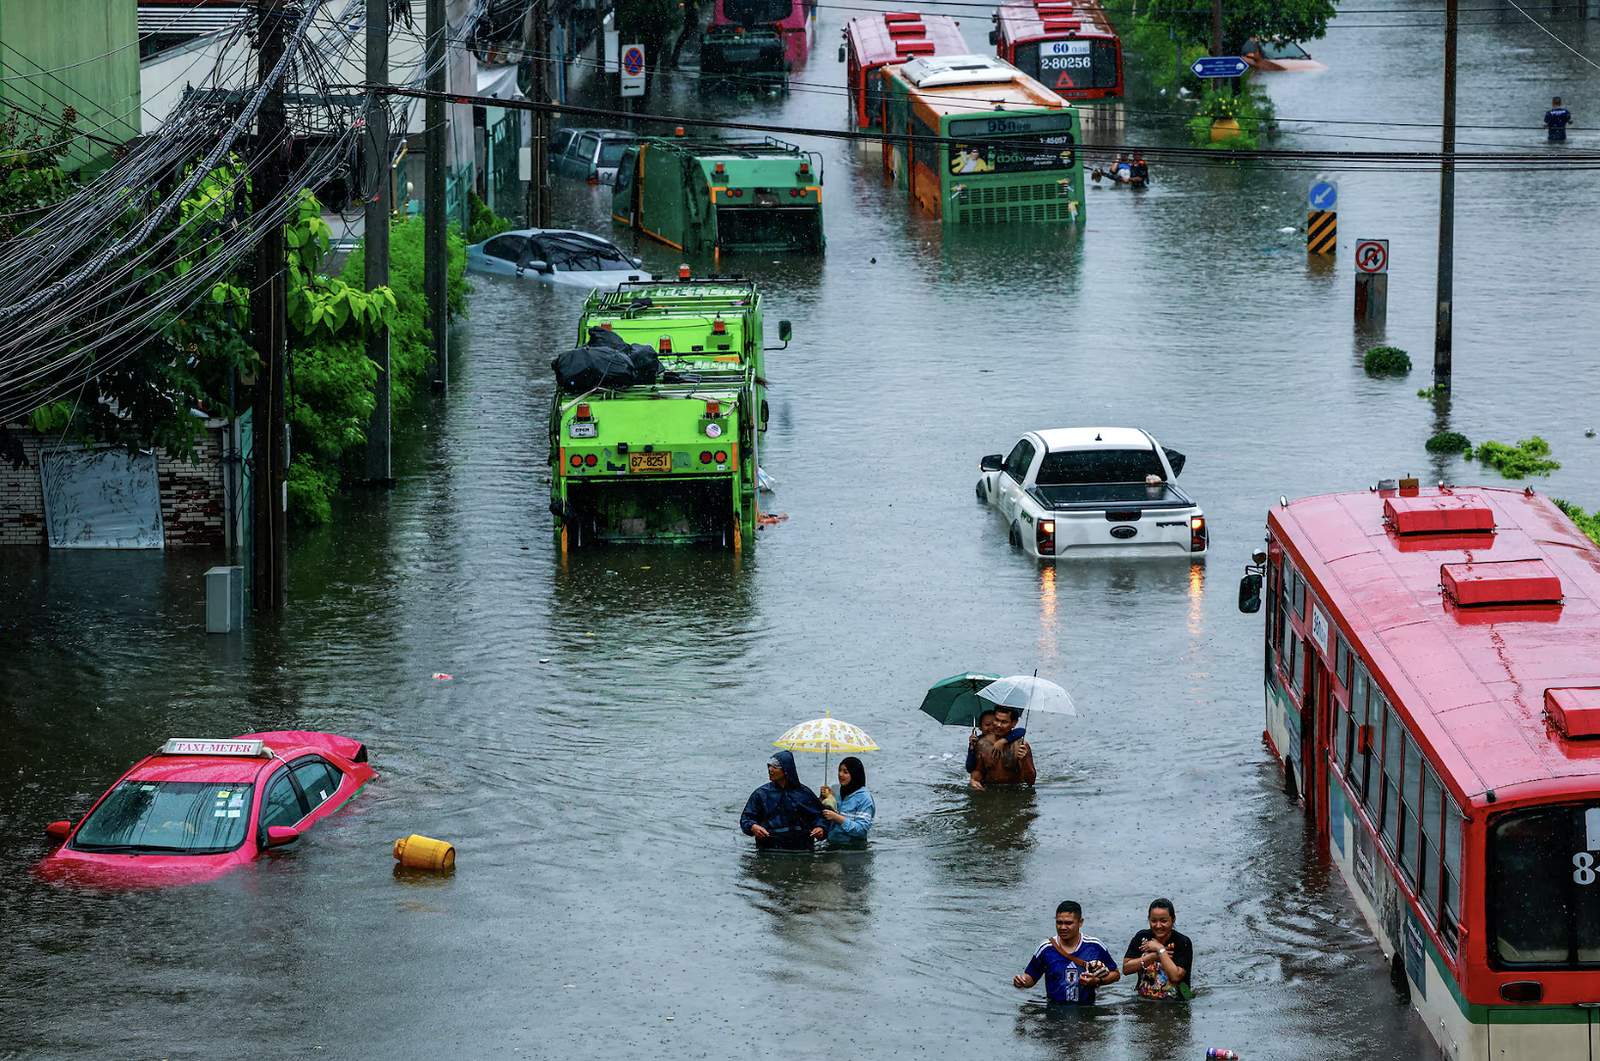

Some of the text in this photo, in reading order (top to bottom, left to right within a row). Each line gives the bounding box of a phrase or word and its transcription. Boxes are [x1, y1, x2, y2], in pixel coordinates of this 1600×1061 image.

[1053, 43, 1069, 53] 60
[1041, 57, 1091, 69] 2-80256
[631, 455, 667, 467] 67-8251
[177, 743, 252, 753] TAXI-METER
[1572, 852, 1600, 885] 8
